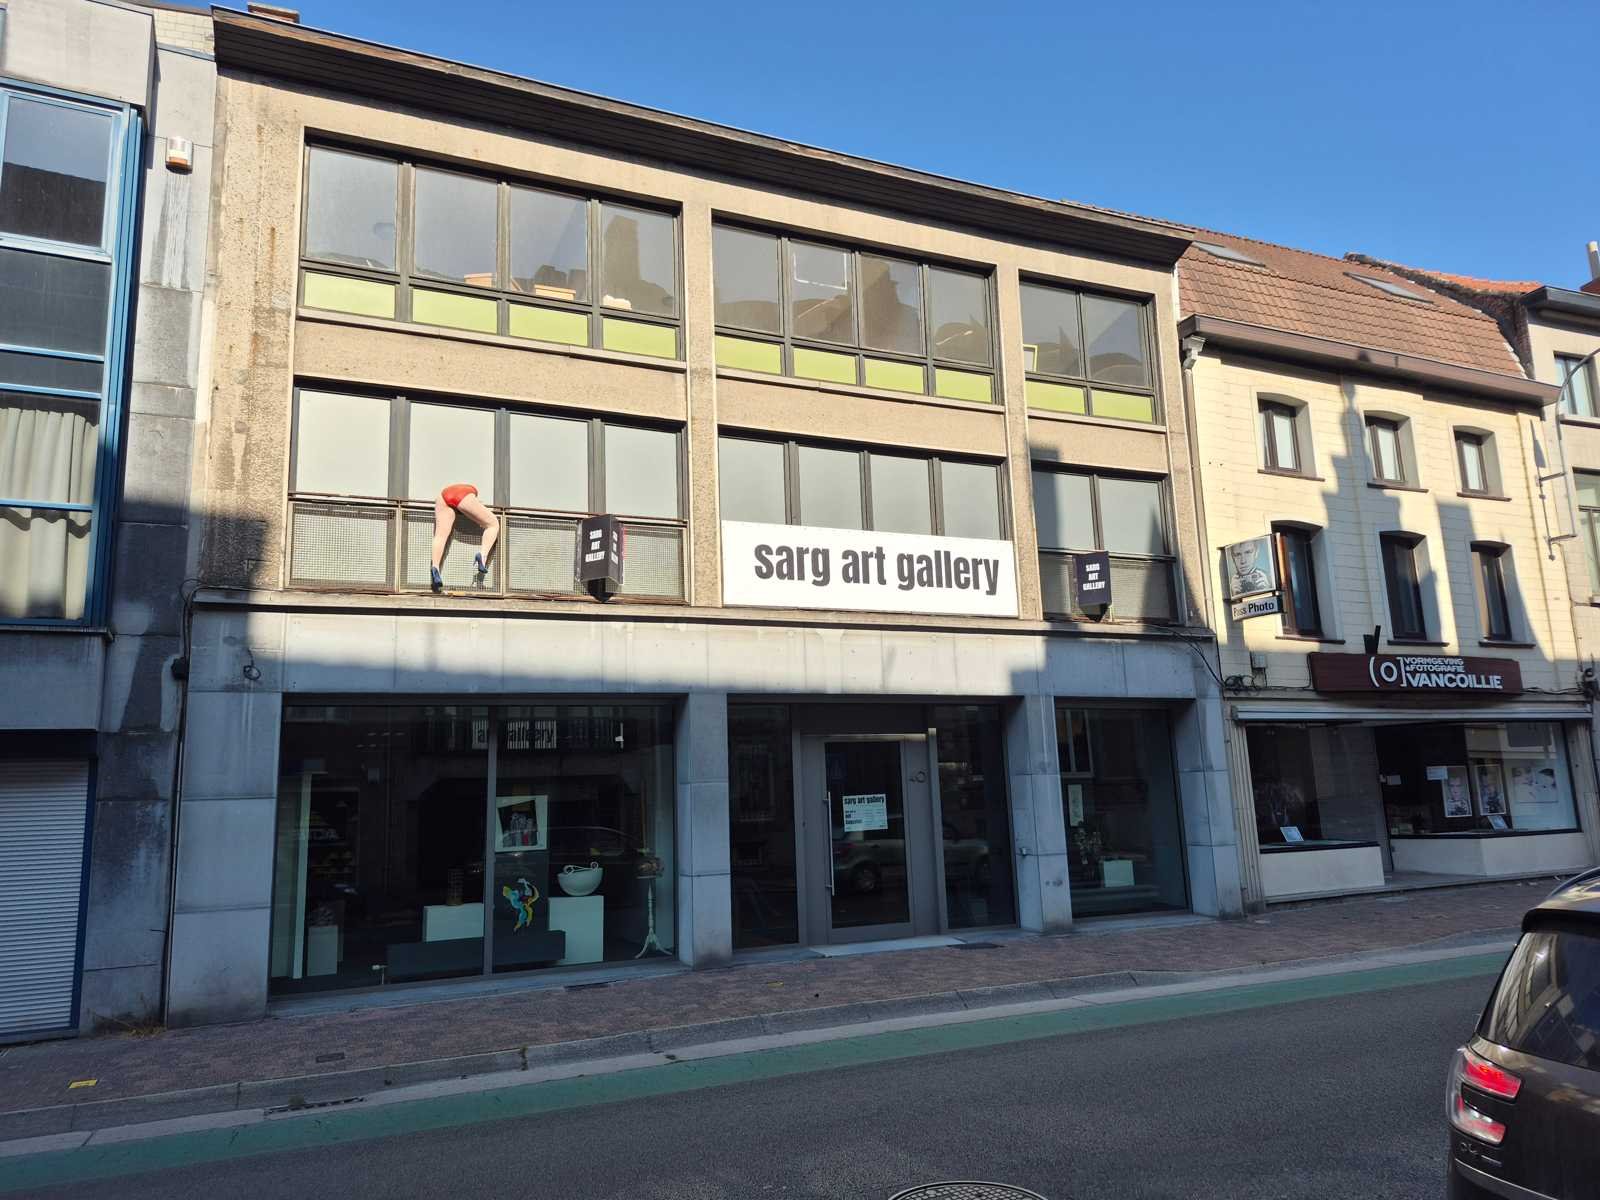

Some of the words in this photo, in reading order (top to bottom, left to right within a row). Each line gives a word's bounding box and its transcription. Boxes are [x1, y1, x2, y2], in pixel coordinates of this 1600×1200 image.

[754, 544, 830, 587] sarg
[841, 546, 887, 585] art
[896, 550, 999, 596] gallery
[1248, 602, 1274, 613] Photo
[1404, 657, 1464, 666] VORMGEVING
[1406, 673, 1503, 689] VANCOILLIE
